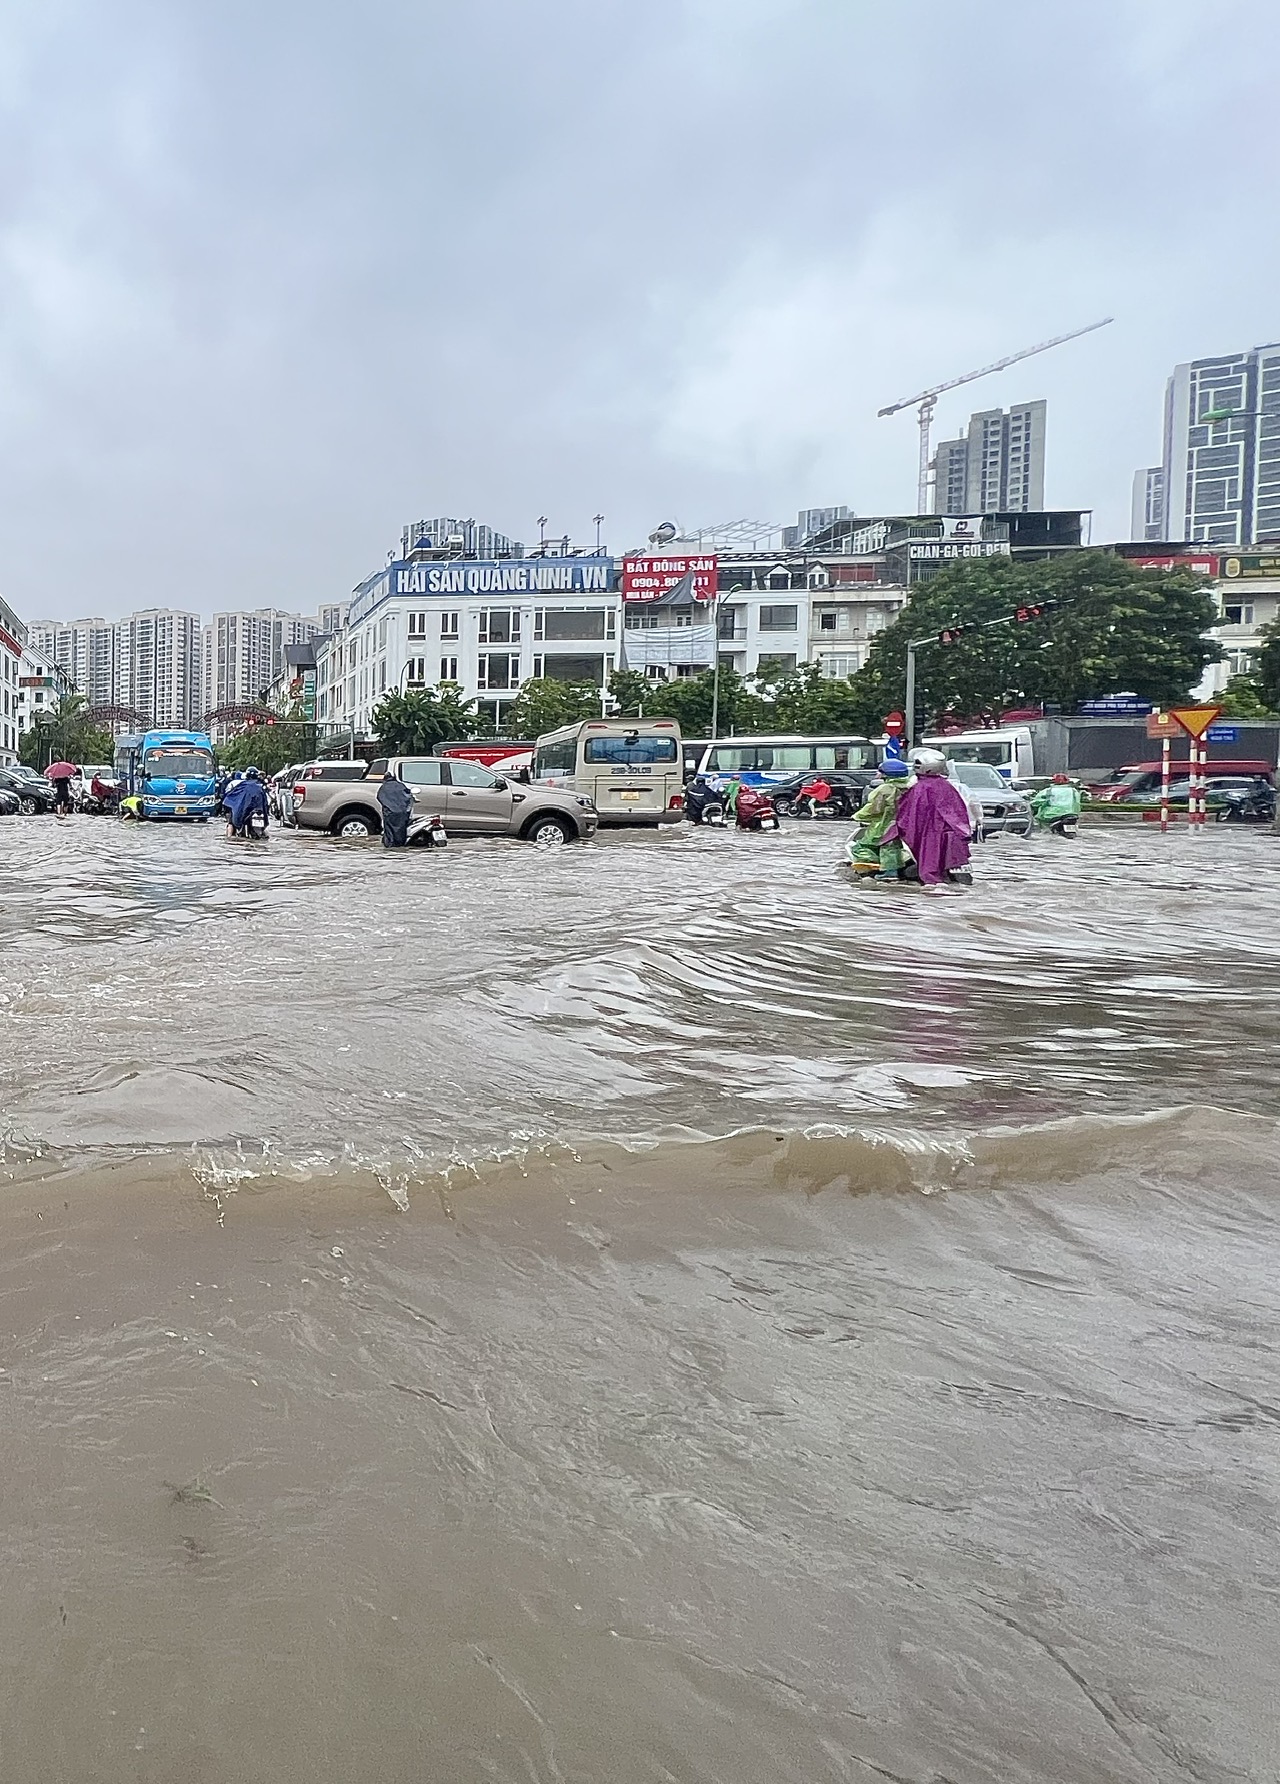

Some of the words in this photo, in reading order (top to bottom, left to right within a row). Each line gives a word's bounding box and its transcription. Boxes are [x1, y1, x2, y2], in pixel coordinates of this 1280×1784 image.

[397, 561, 425, 593] HẢI
[429, 562, 465, 592] SẢN
[468, 561, 527, 593] QUẢNG
[530, 568, 572, 590] NINH
